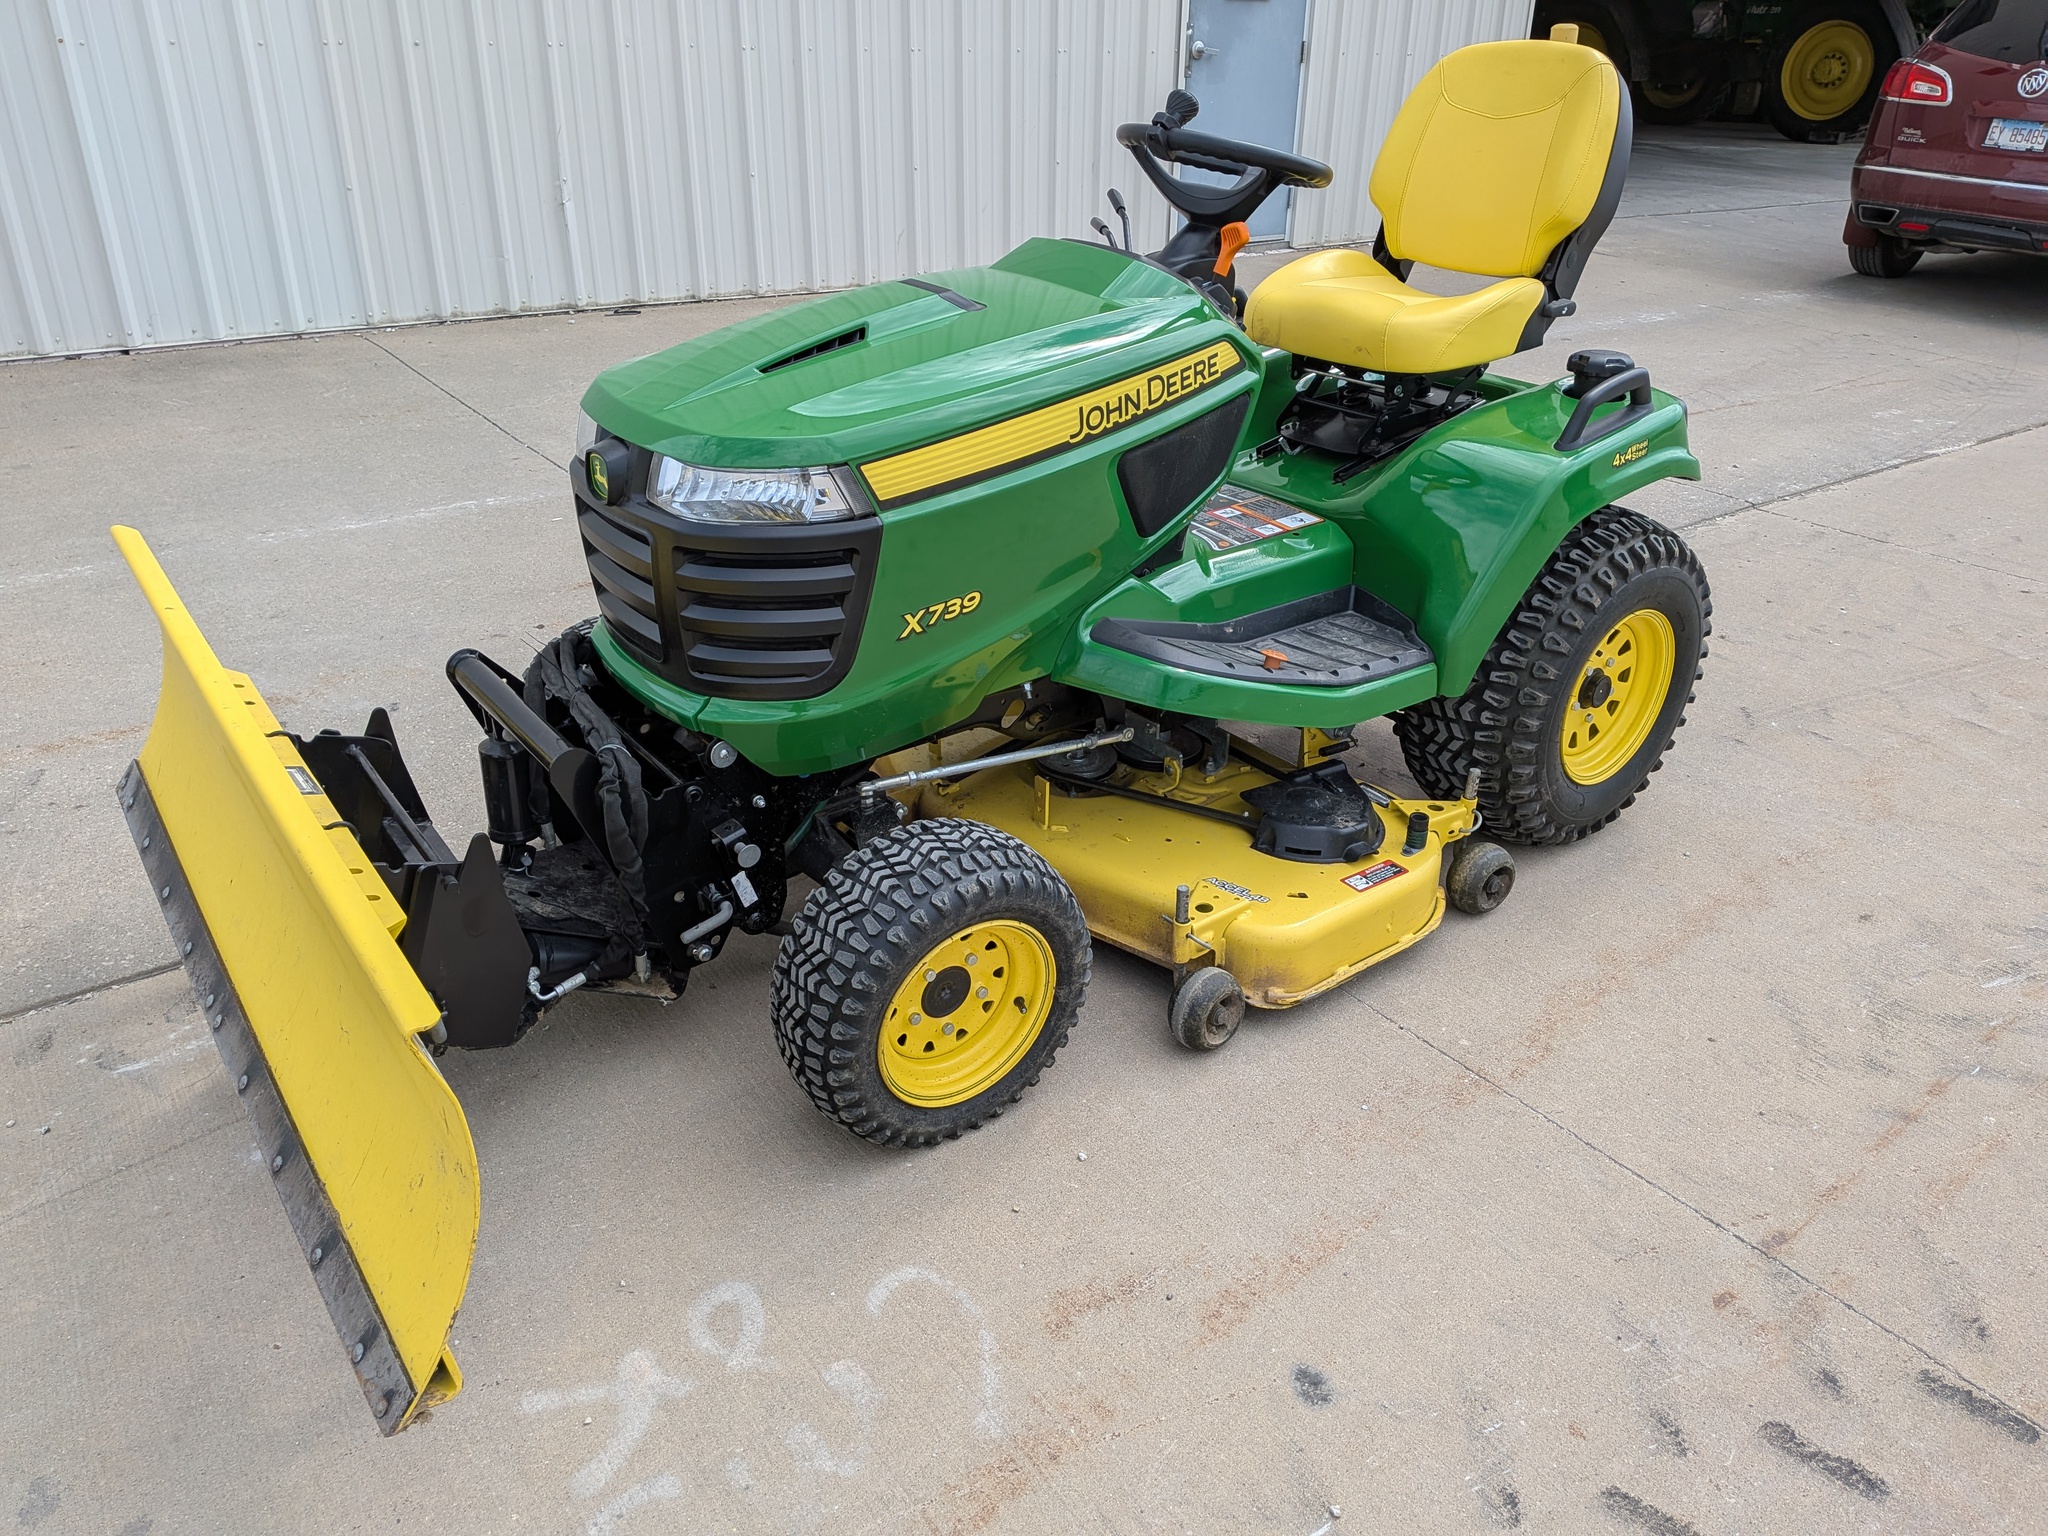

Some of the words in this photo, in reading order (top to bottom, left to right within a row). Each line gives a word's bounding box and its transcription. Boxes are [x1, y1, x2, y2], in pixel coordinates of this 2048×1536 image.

[1897, 135, 1927, 144] BUICK
[1068, 386, 1142, 441] JOHN
[1146, 351, 1221, 407] DEERE
[1612, 446, 1633, 468] 4x4
[896, 590, 983, 641] X739
[1204, 876, 1252, 895] ACCEL
